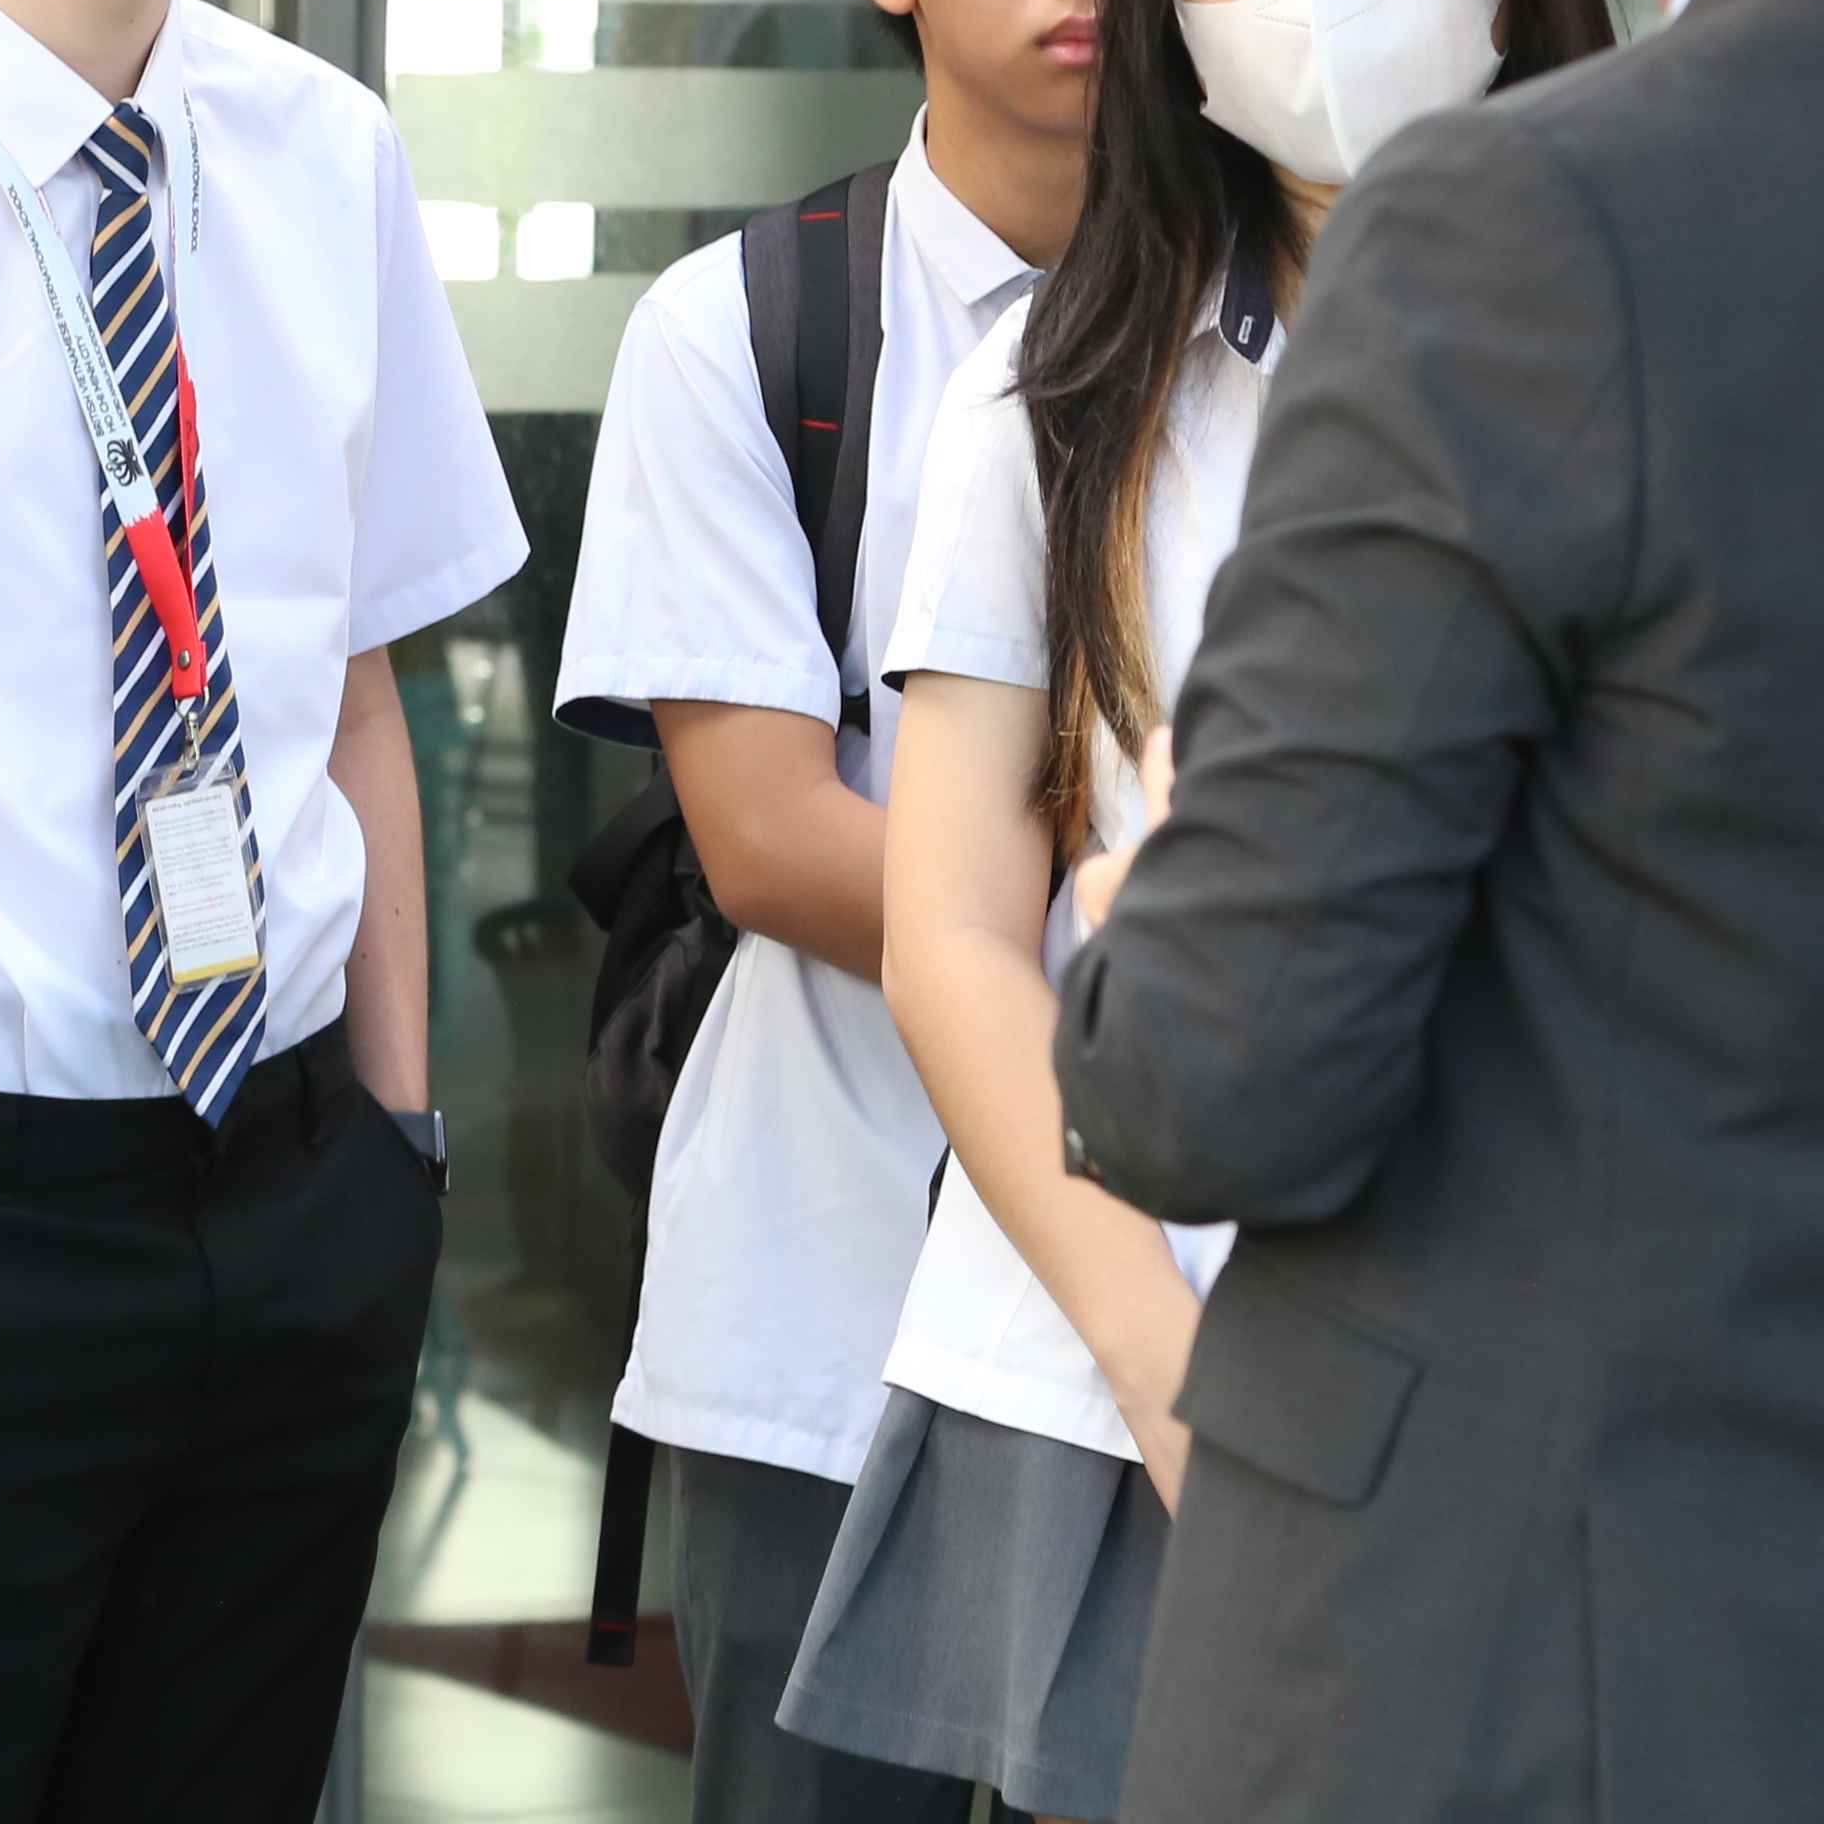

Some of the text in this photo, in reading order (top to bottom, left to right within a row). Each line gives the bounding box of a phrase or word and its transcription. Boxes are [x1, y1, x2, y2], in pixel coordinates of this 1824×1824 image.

[190, 206, 199, 254] SCHOOL
[5, 182, 105, 437] BRITISH VIETNAMESE INTERNATIONAL SCHOOL
[74, 334, 116, 434] HO CHI MINH CITY
